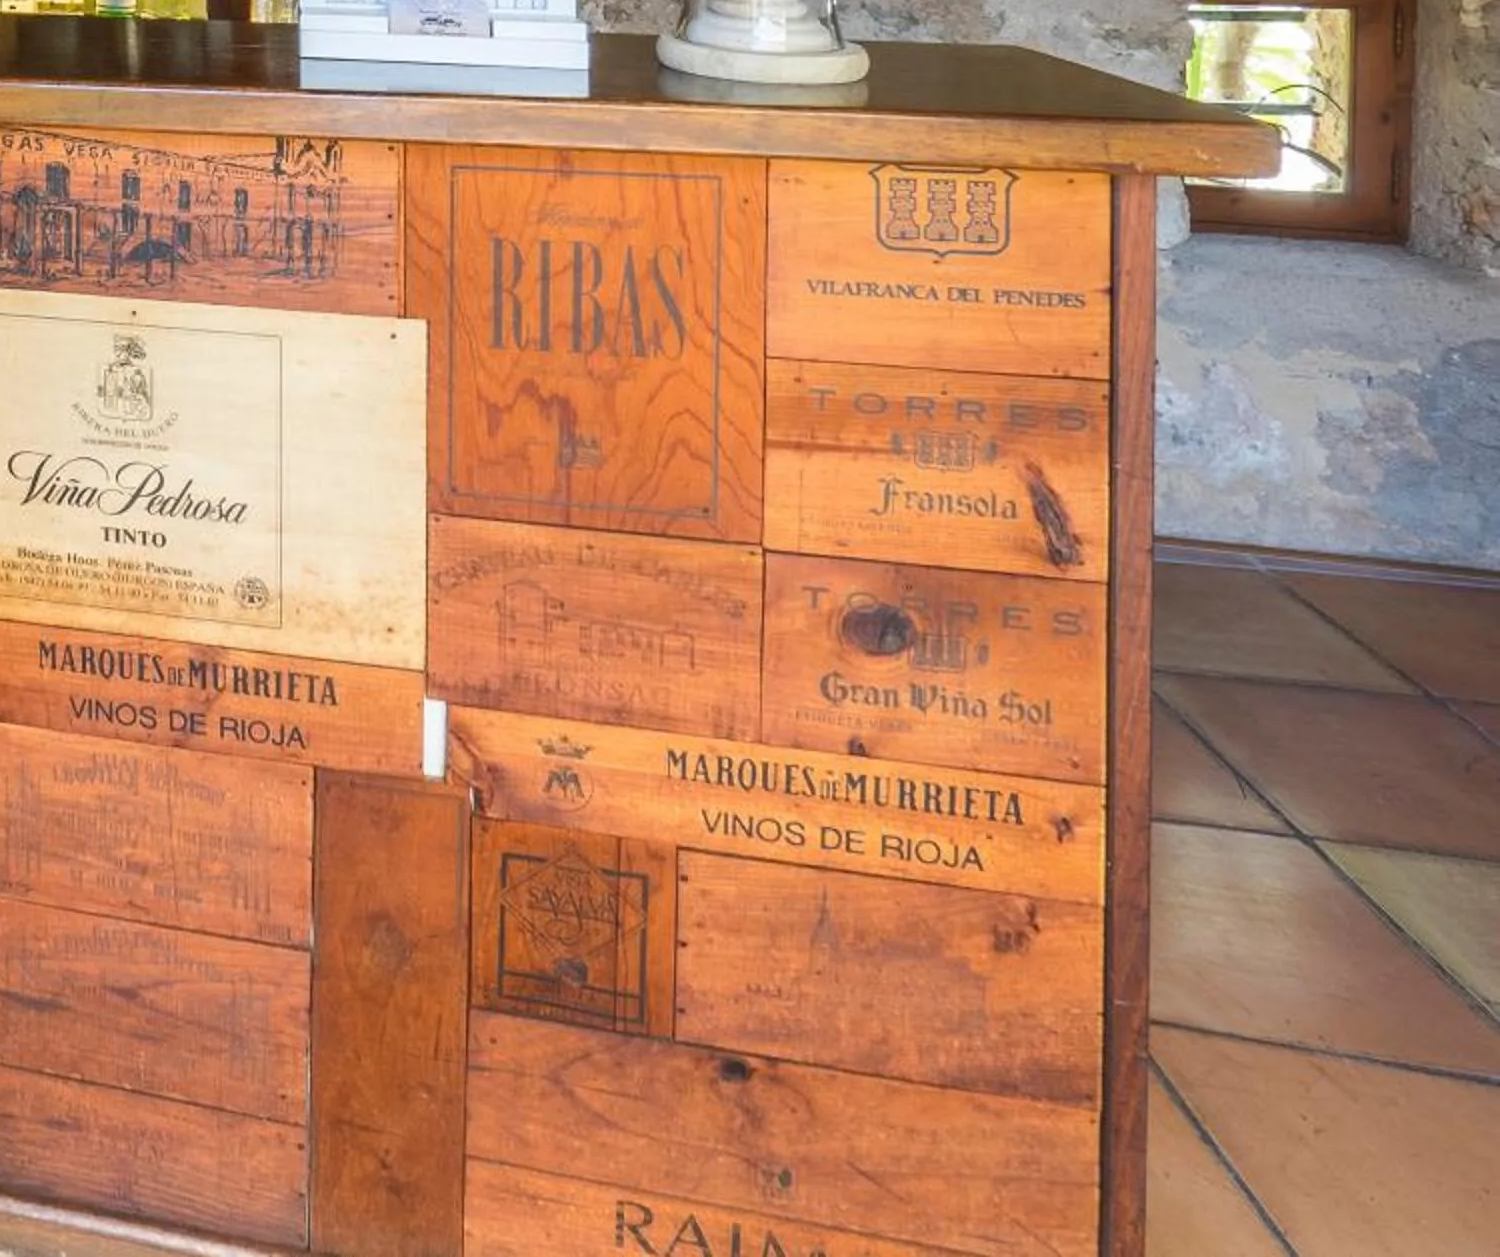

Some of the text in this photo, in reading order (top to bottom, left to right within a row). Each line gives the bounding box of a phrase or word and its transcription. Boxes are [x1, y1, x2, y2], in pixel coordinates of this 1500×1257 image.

[488, 236, 687, 362] RIBAS
[806, 278, 1087, 309] VILAFRANCA DEL PENEDES
[807, 387, 1089, 432] TORRES
[7, 449, 249, 525] Viña Pedrosa
[868, 474, 1019, 521] Fransola
[100, 525, 168, 550] TINTO
[801, 585, 1088, 637] TORRES
[37, 639, 167, 684] MARQUES
[188, 657, 340, 707] MURRIETA
[819, 670, 1053, 726] Gran Viña Sol
[68, 695, 308, 751] VINOS DE RIOJA
[665, 748, 818, 800] MARQUES
[843, 771, 1027, 826] MURRIETA
[700, 807, 986, 873] VINOS DE RIOJA
